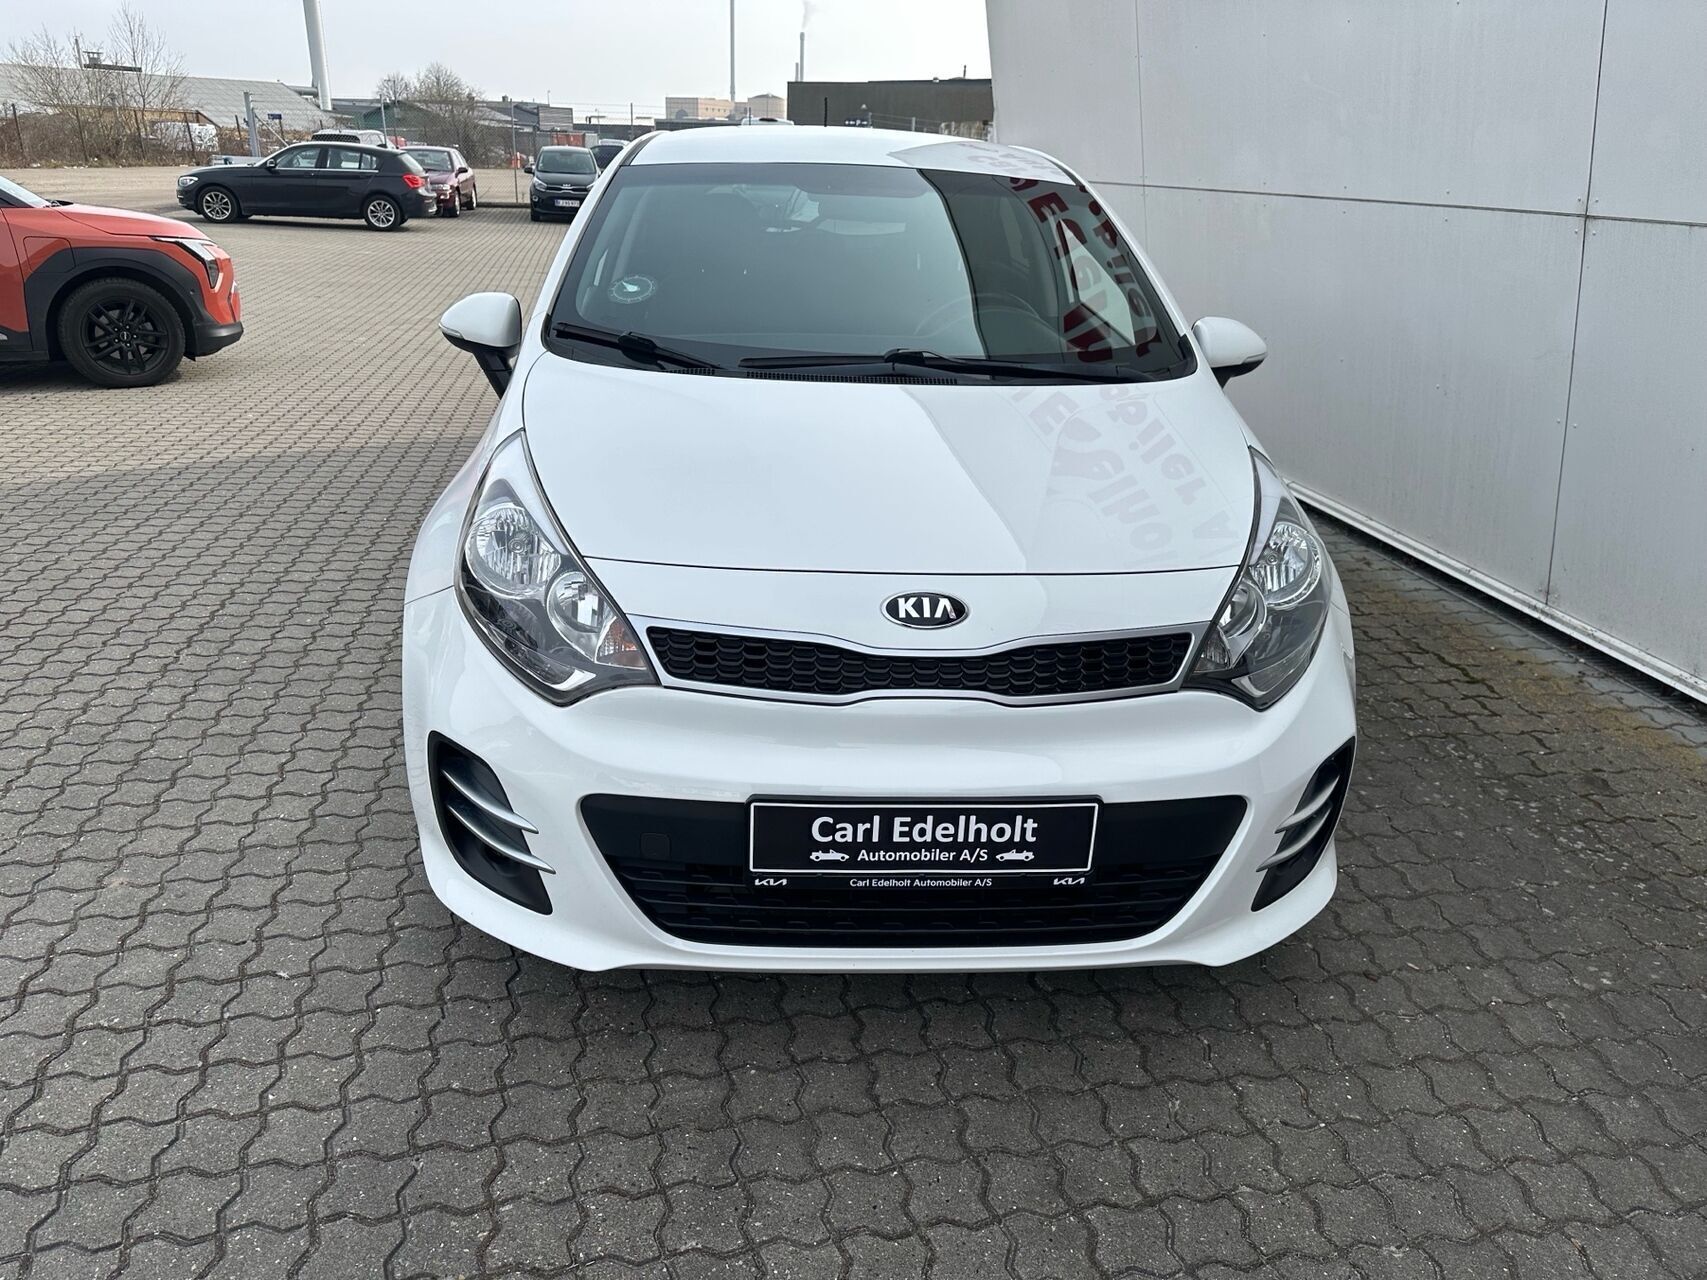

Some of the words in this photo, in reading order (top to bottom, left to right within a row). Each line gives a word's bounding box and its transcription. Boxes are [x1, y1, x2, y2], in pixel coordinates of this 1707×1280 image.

[896, 596, 957, 619] KIA
[811, 815, 880, 843] Carl
[892, 814, 1038, 843] Edelholt
[857, 848, 956, 862] Automobiler
[959, 848, 988, 863] A/S
[849, 878, 870, 887] Carl
[871, 878, 912, 887] Edelholt
[913, 878, 973, 887] Automobiler
[974, 878, 993, 887] A/S
